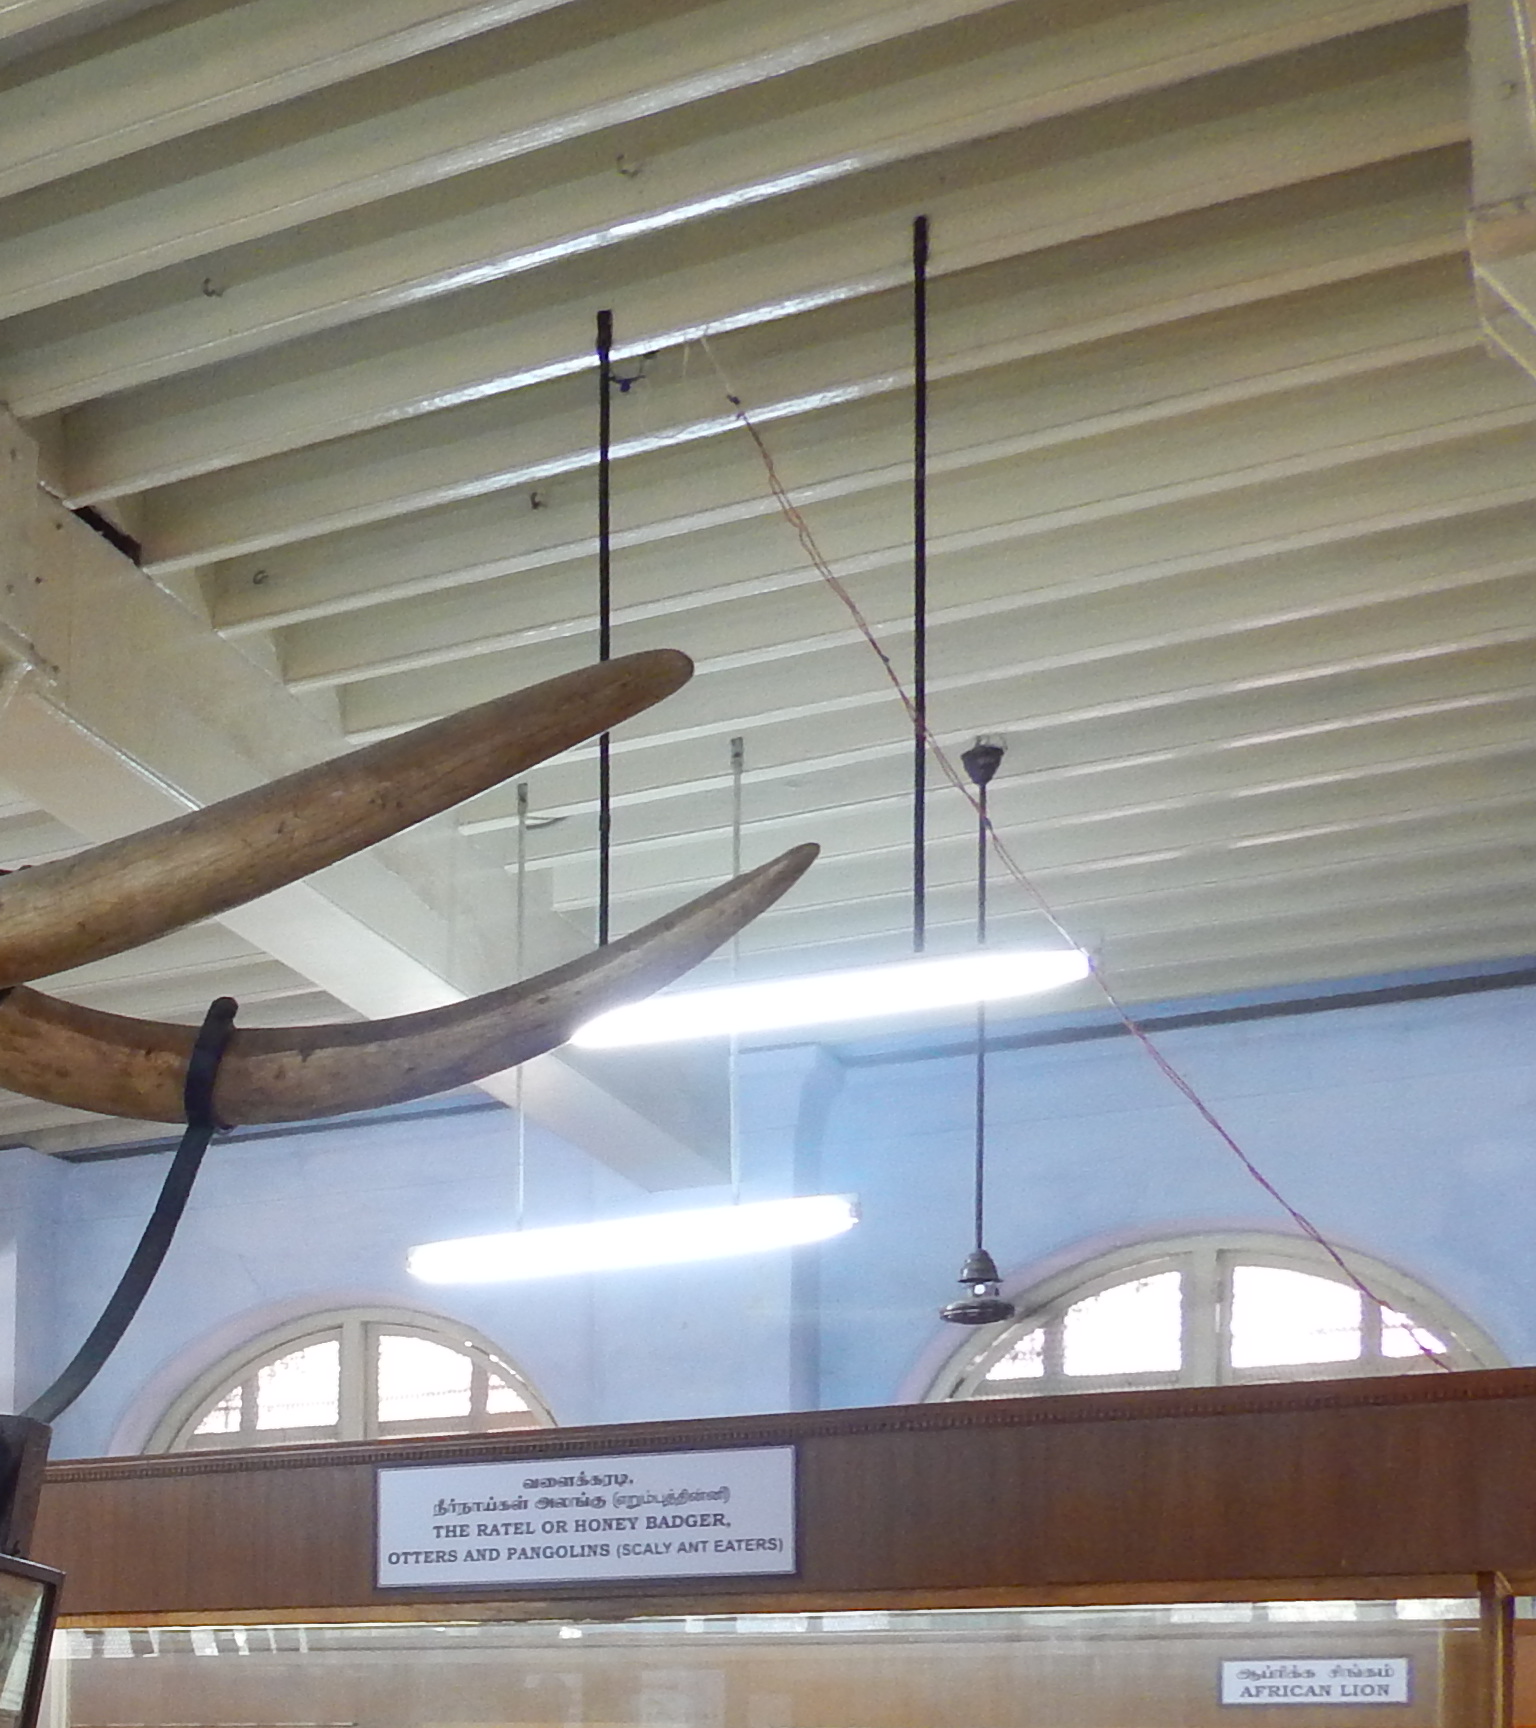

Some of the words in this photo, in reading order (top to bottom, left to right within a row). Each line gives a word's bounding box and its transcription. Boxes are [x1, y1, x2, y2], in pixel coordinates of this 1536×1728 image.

[433, 1524, 470, 1539] THE
[477, 1521, 535, 1537] RATEL
[541, 1520, 568, 1534] OR
[574, 1516, 639, 1533] HONEY
[388, 1550, 458, 1565] OTTERS
[463, 1548, 500, 1562] AND
[507, 1543, 610, 1561] PANGOLINS
[616, 1542, 672, 1559] (SCALY
[678, 1540, 709, 1554] ANT
[714, 1537, 784, 1553] EATERS)
[1239, 1684, 1332, 1698] AFRICAN
[1340, 1684, 1390, 1696] LION
